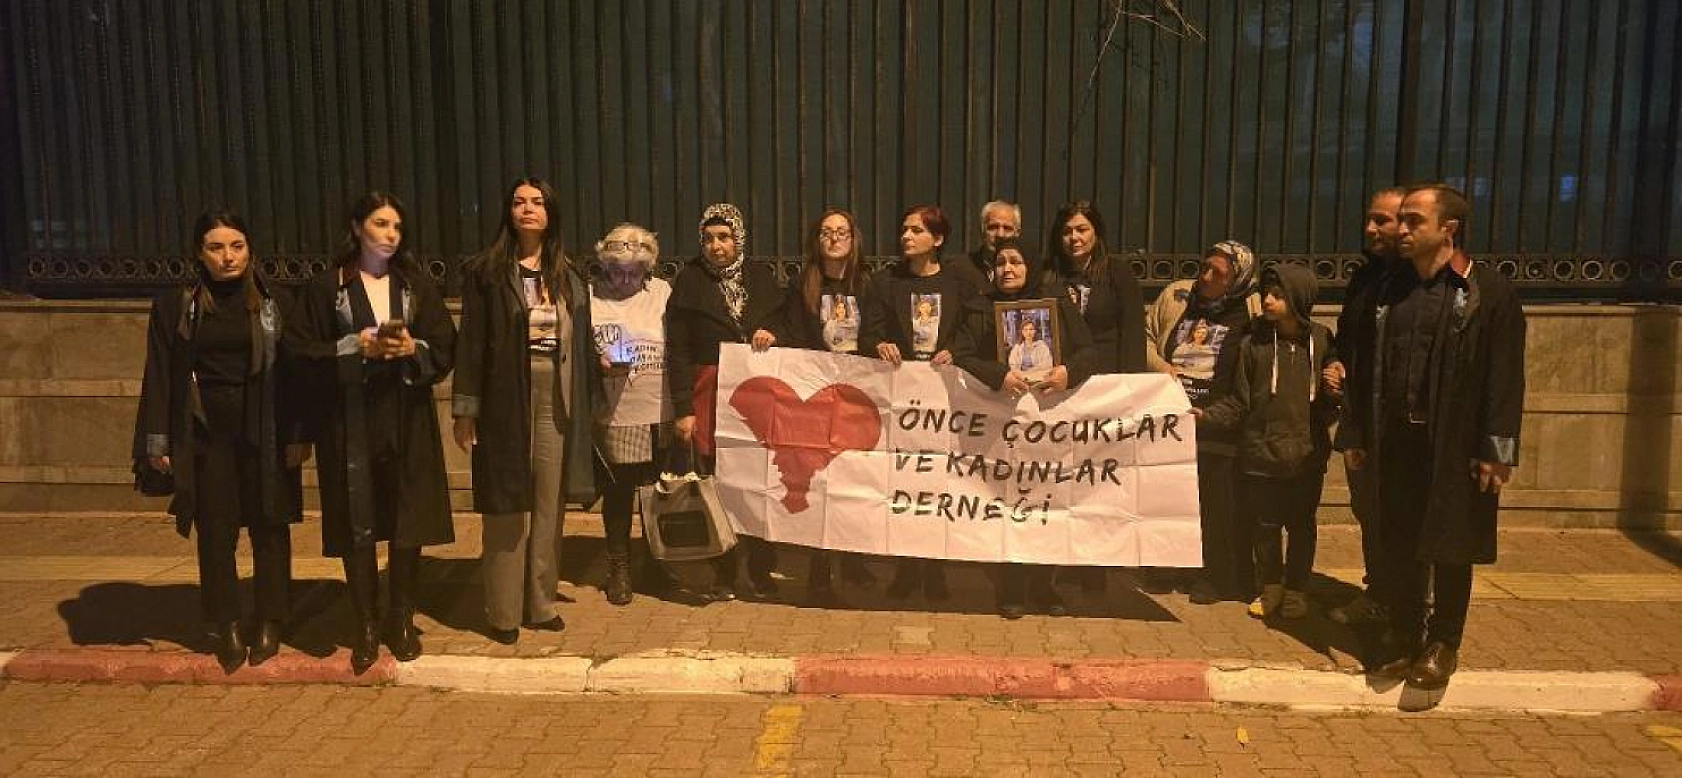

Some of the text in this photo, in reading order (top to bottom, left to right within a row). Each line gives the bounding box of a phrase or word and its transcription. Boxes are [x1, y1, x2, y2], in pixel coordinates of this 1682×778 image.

[898, 399, 1182, 448] ÖNCE ÇOCUKLAR
[895, 447, 1121, 485] VE KADINLAR
[891, 487, 1053, 525] DERNEĞİ
